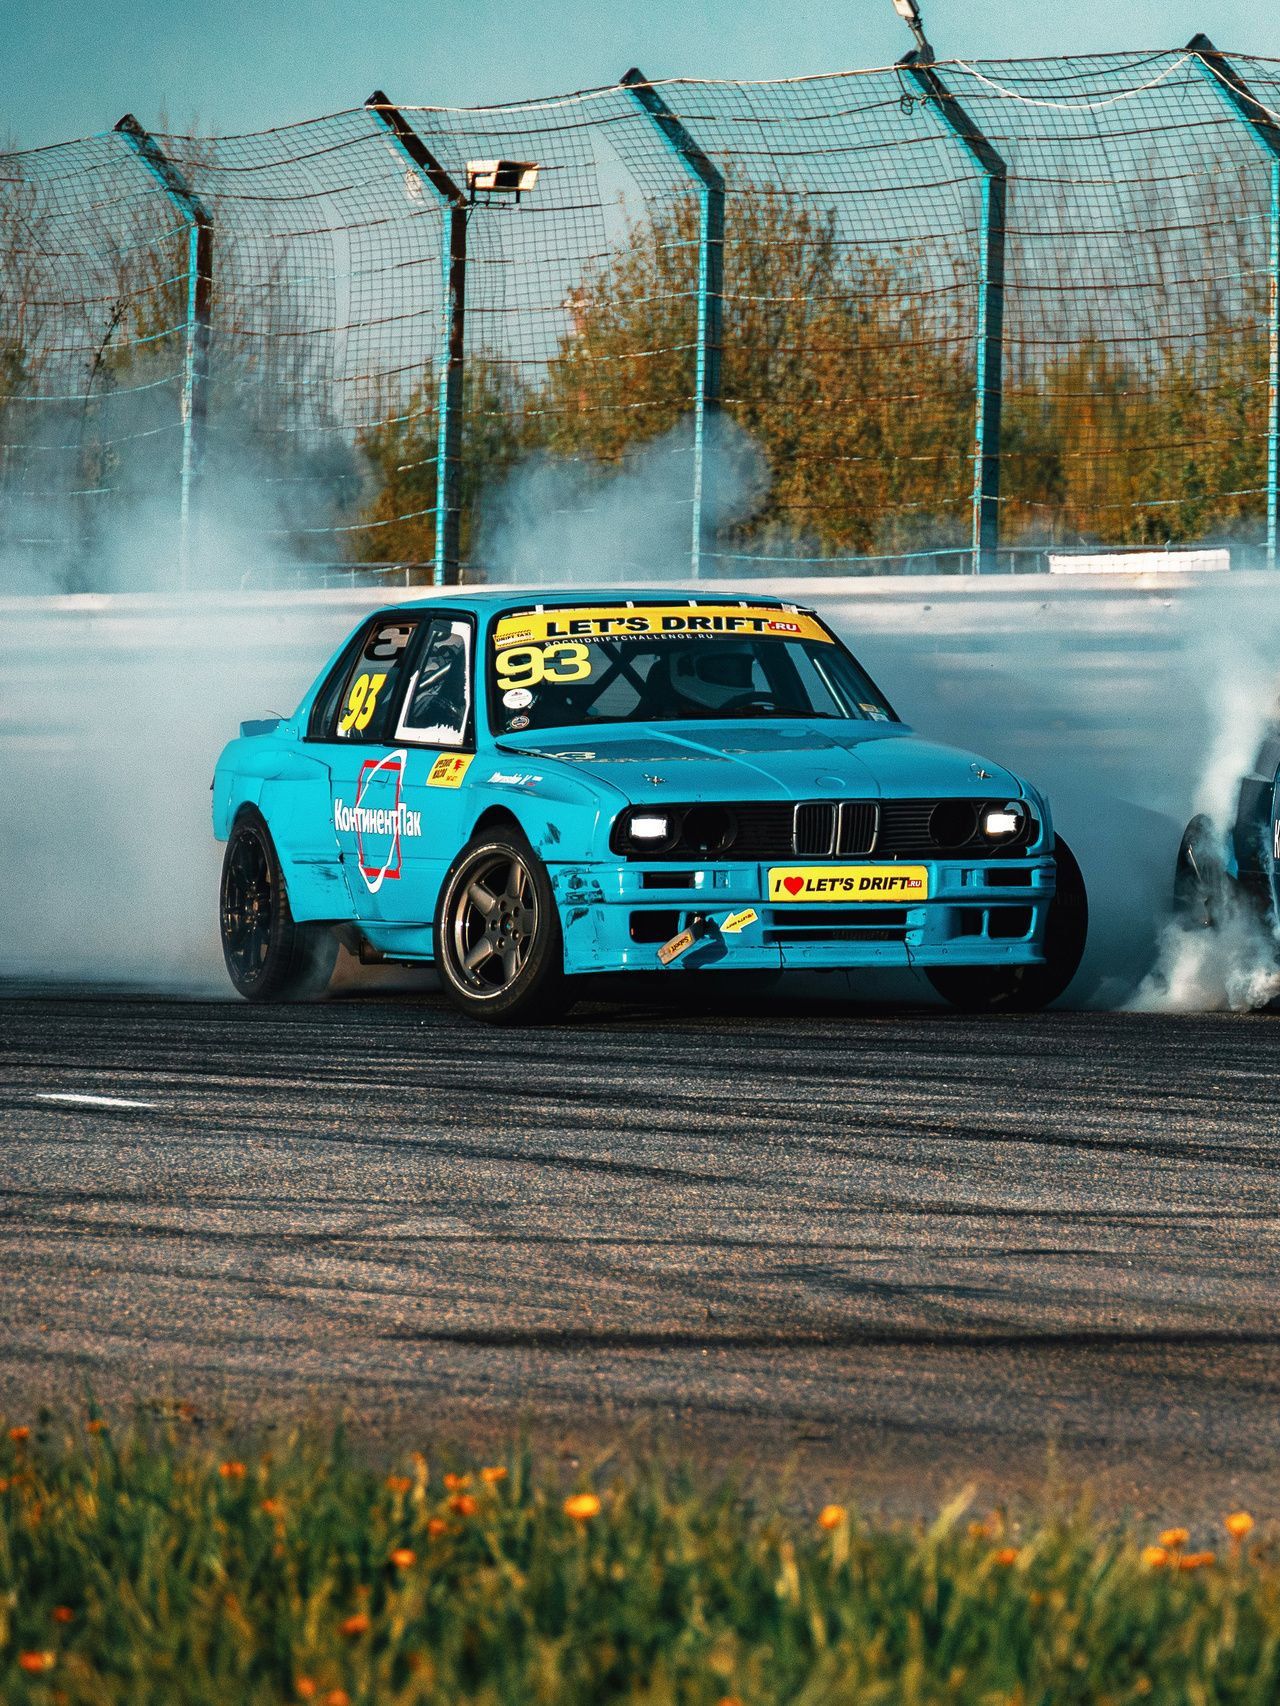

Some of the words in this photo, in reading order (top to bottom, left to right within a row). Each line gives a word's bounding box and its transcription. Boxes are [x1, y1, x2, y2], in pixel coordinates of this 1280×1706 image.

[546, 616, 650, 638] LET'S
[495, 643, 592, 690] 93
[340, 673, 387, 731] 93
[334, 798, 422, 837] КонтинентПак
[775, 879, 781, 892] I
[805, 878, 854, 892] LET'S
